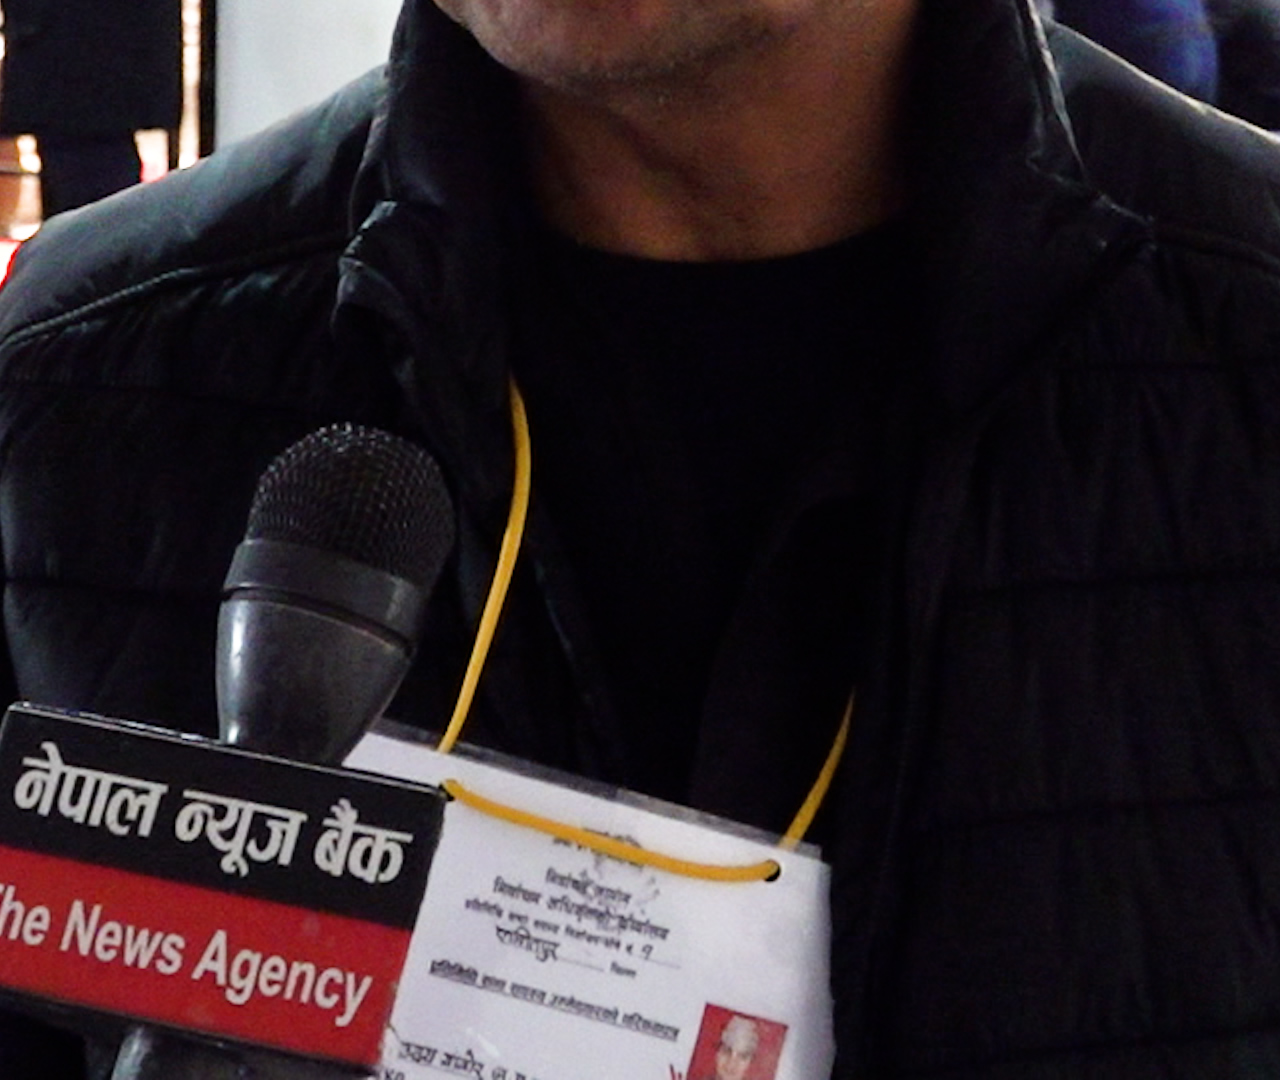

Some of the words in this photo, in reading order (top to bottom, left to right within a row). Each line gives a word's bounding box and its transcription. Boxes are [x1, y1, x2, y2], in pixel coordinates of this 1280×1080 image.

[14, 741, 169, 837] नेपाल
[174, 789, 308, 877] न्यूज
[60, 899, 186, 976] News
[191, 929, 373, 1028] Agency
